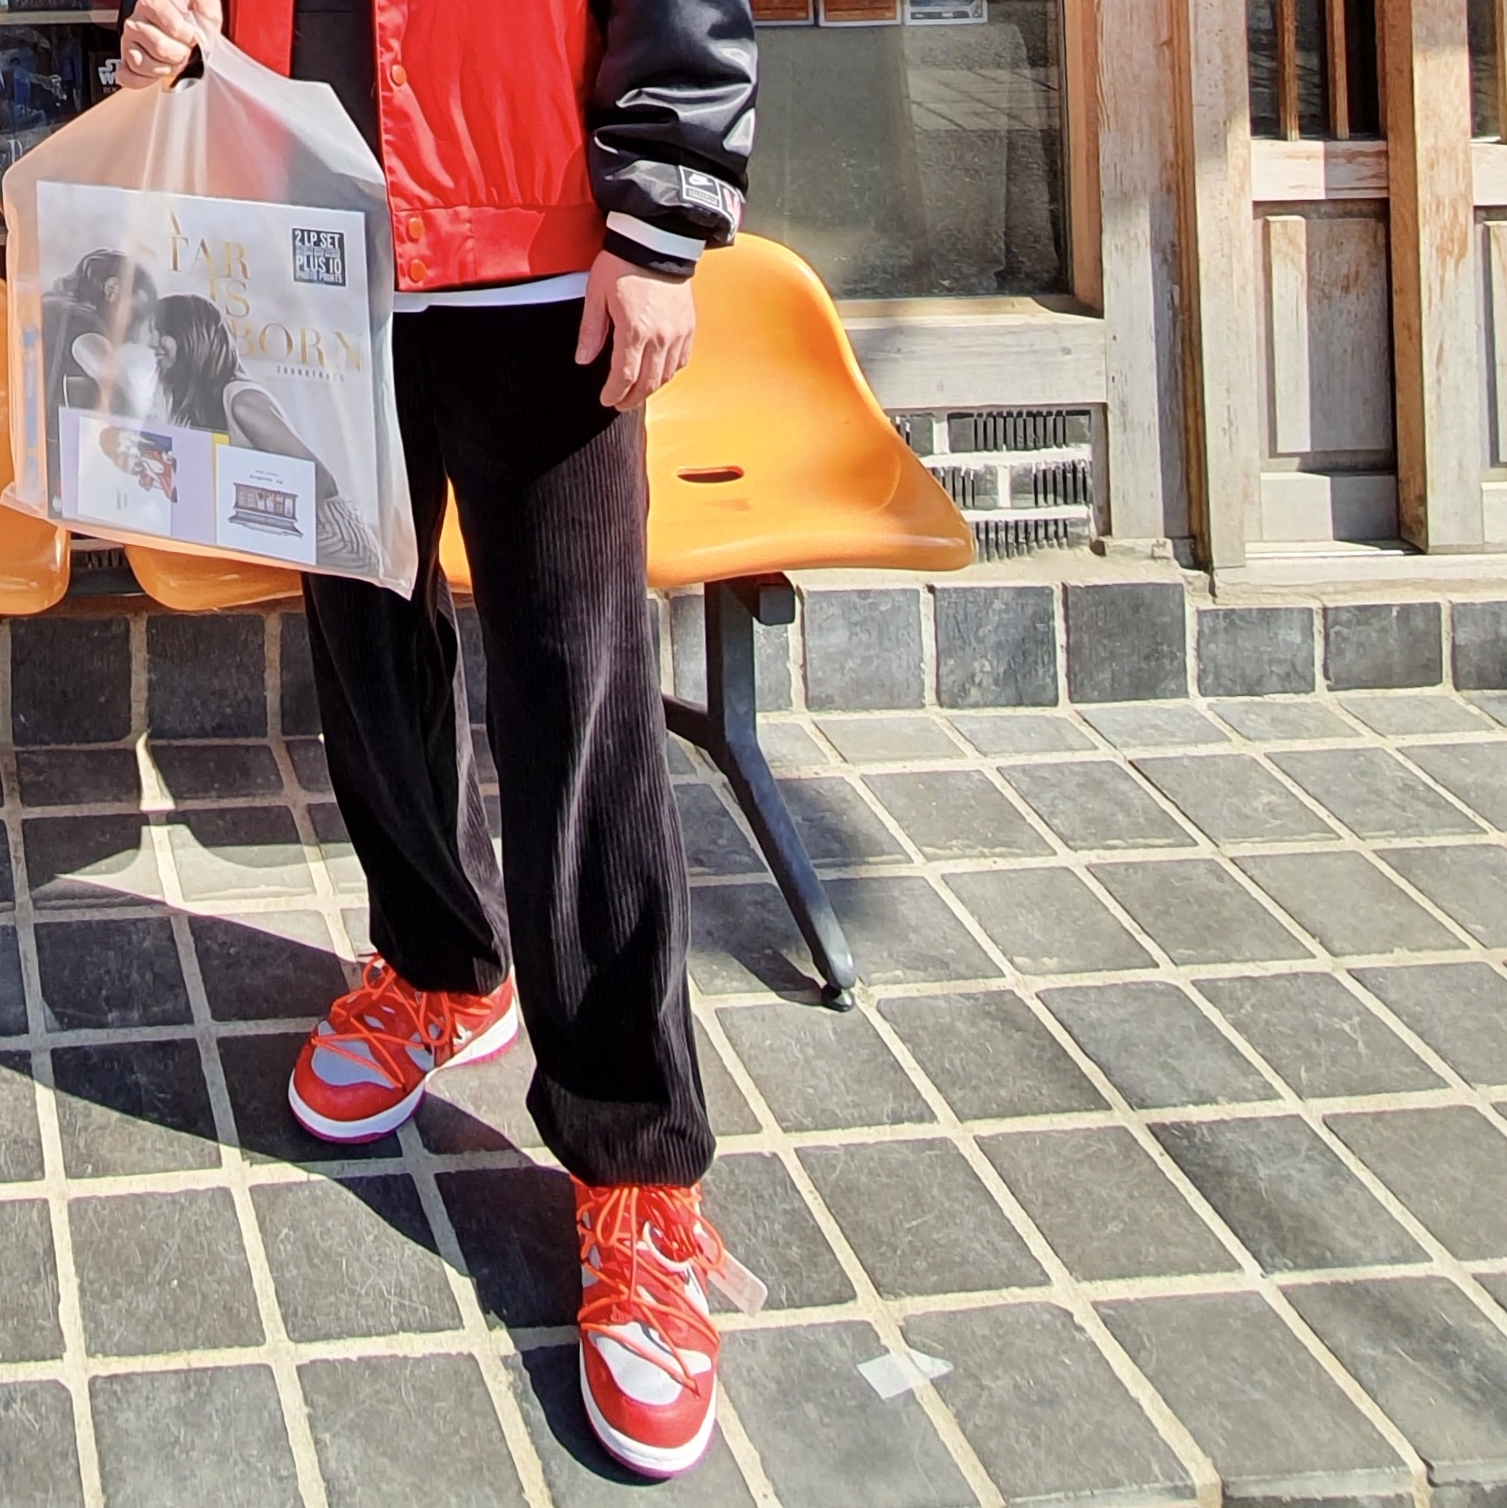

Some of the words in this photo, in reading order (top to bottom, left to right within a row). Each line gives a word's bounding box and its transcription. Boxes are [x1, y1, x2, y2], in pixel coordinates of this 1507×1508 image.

[295, 229, 302, 246] 2
[304, 231, 318, 248] LP
[320, 232, 340, 249] SET
[296, 254, 326, 273] PLUS
[329, 257, 342, 274] 10
[208, 276, 252, 319] IS
[229, 319, 362, 373] BORN
